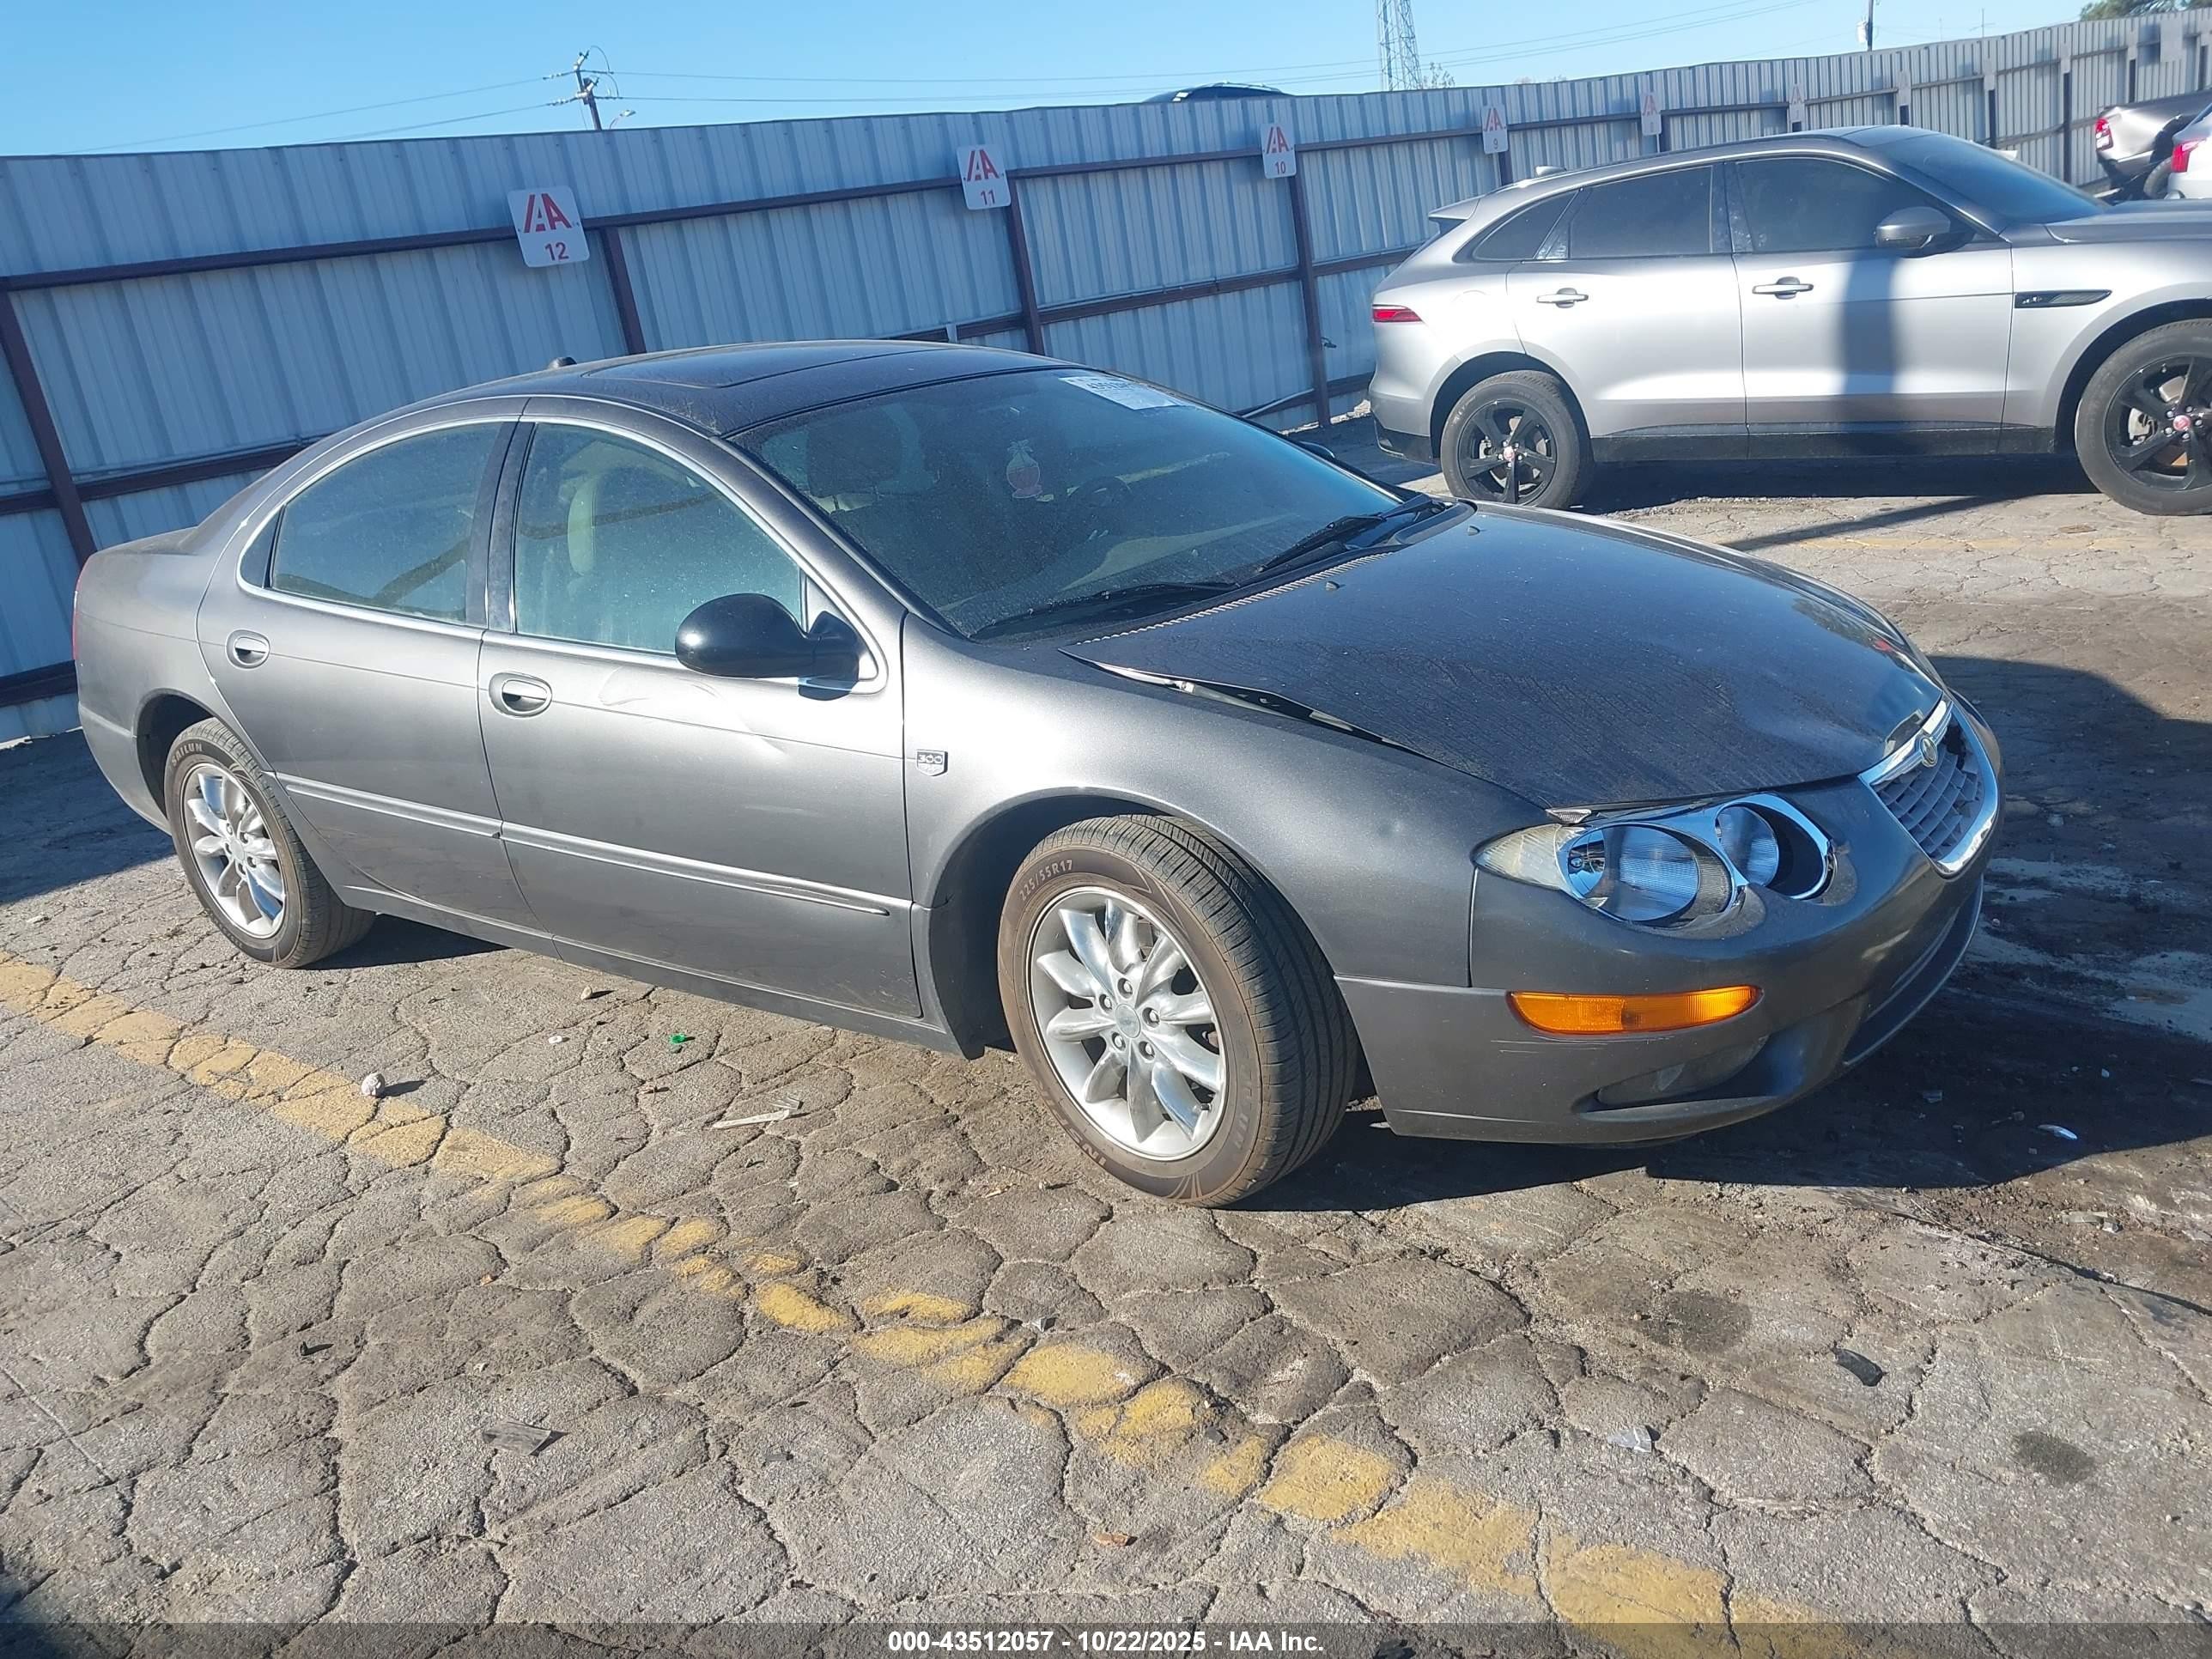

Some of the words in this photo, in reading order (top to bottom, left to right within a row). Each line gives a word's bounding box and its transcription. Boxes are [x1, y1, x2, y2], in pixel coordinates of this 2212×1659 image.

[1492, 138, 1498, 150] 9
[1274, 157, 1287, 175] 10
[981, 188, 996, 205] 11
[544, 240, 569, 262] 12
[171, 743, 203, 767] SAILUN
[917, 754, 943, 765] 300
[1018, 859, 1073, 902] 225/55R17
